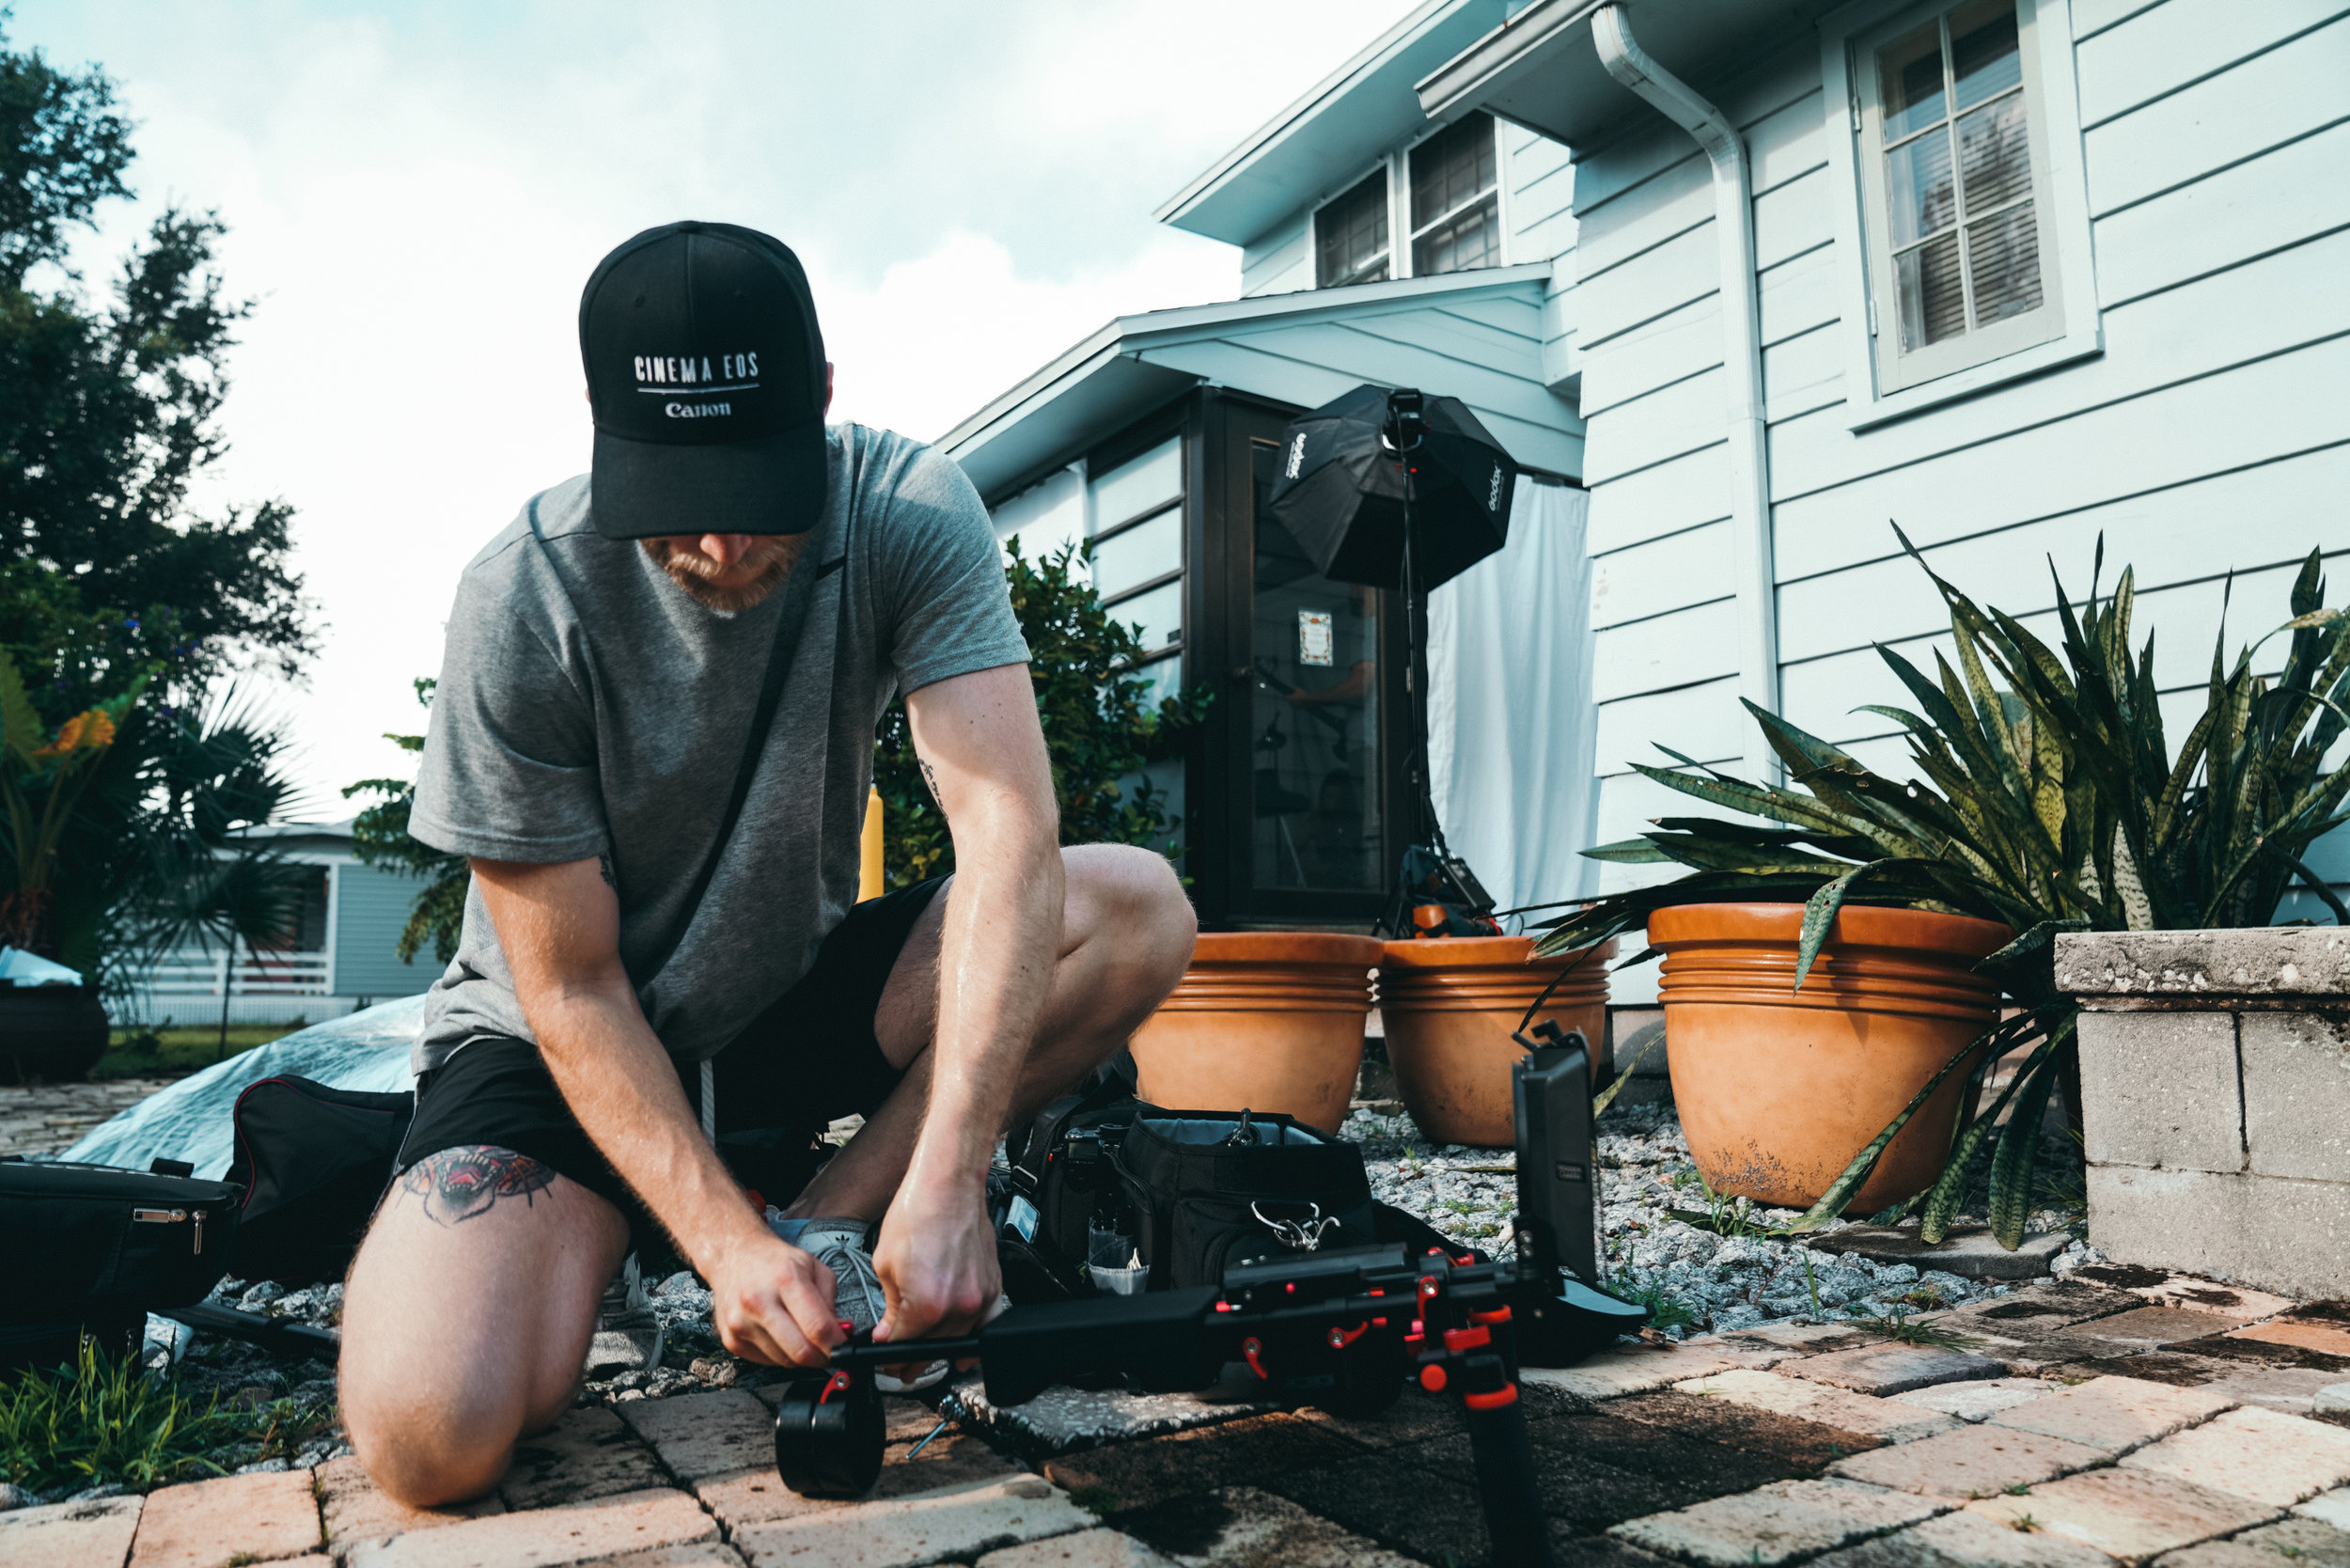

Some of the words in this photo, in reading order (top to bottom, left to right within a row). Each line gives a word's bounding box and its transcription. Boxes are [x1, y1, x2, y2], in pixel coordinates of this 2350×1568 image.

[634, 354, 713, 384] CINEMA
[723, 351, 759, 380] EOS
[665, 401, 731, 418] Canon
